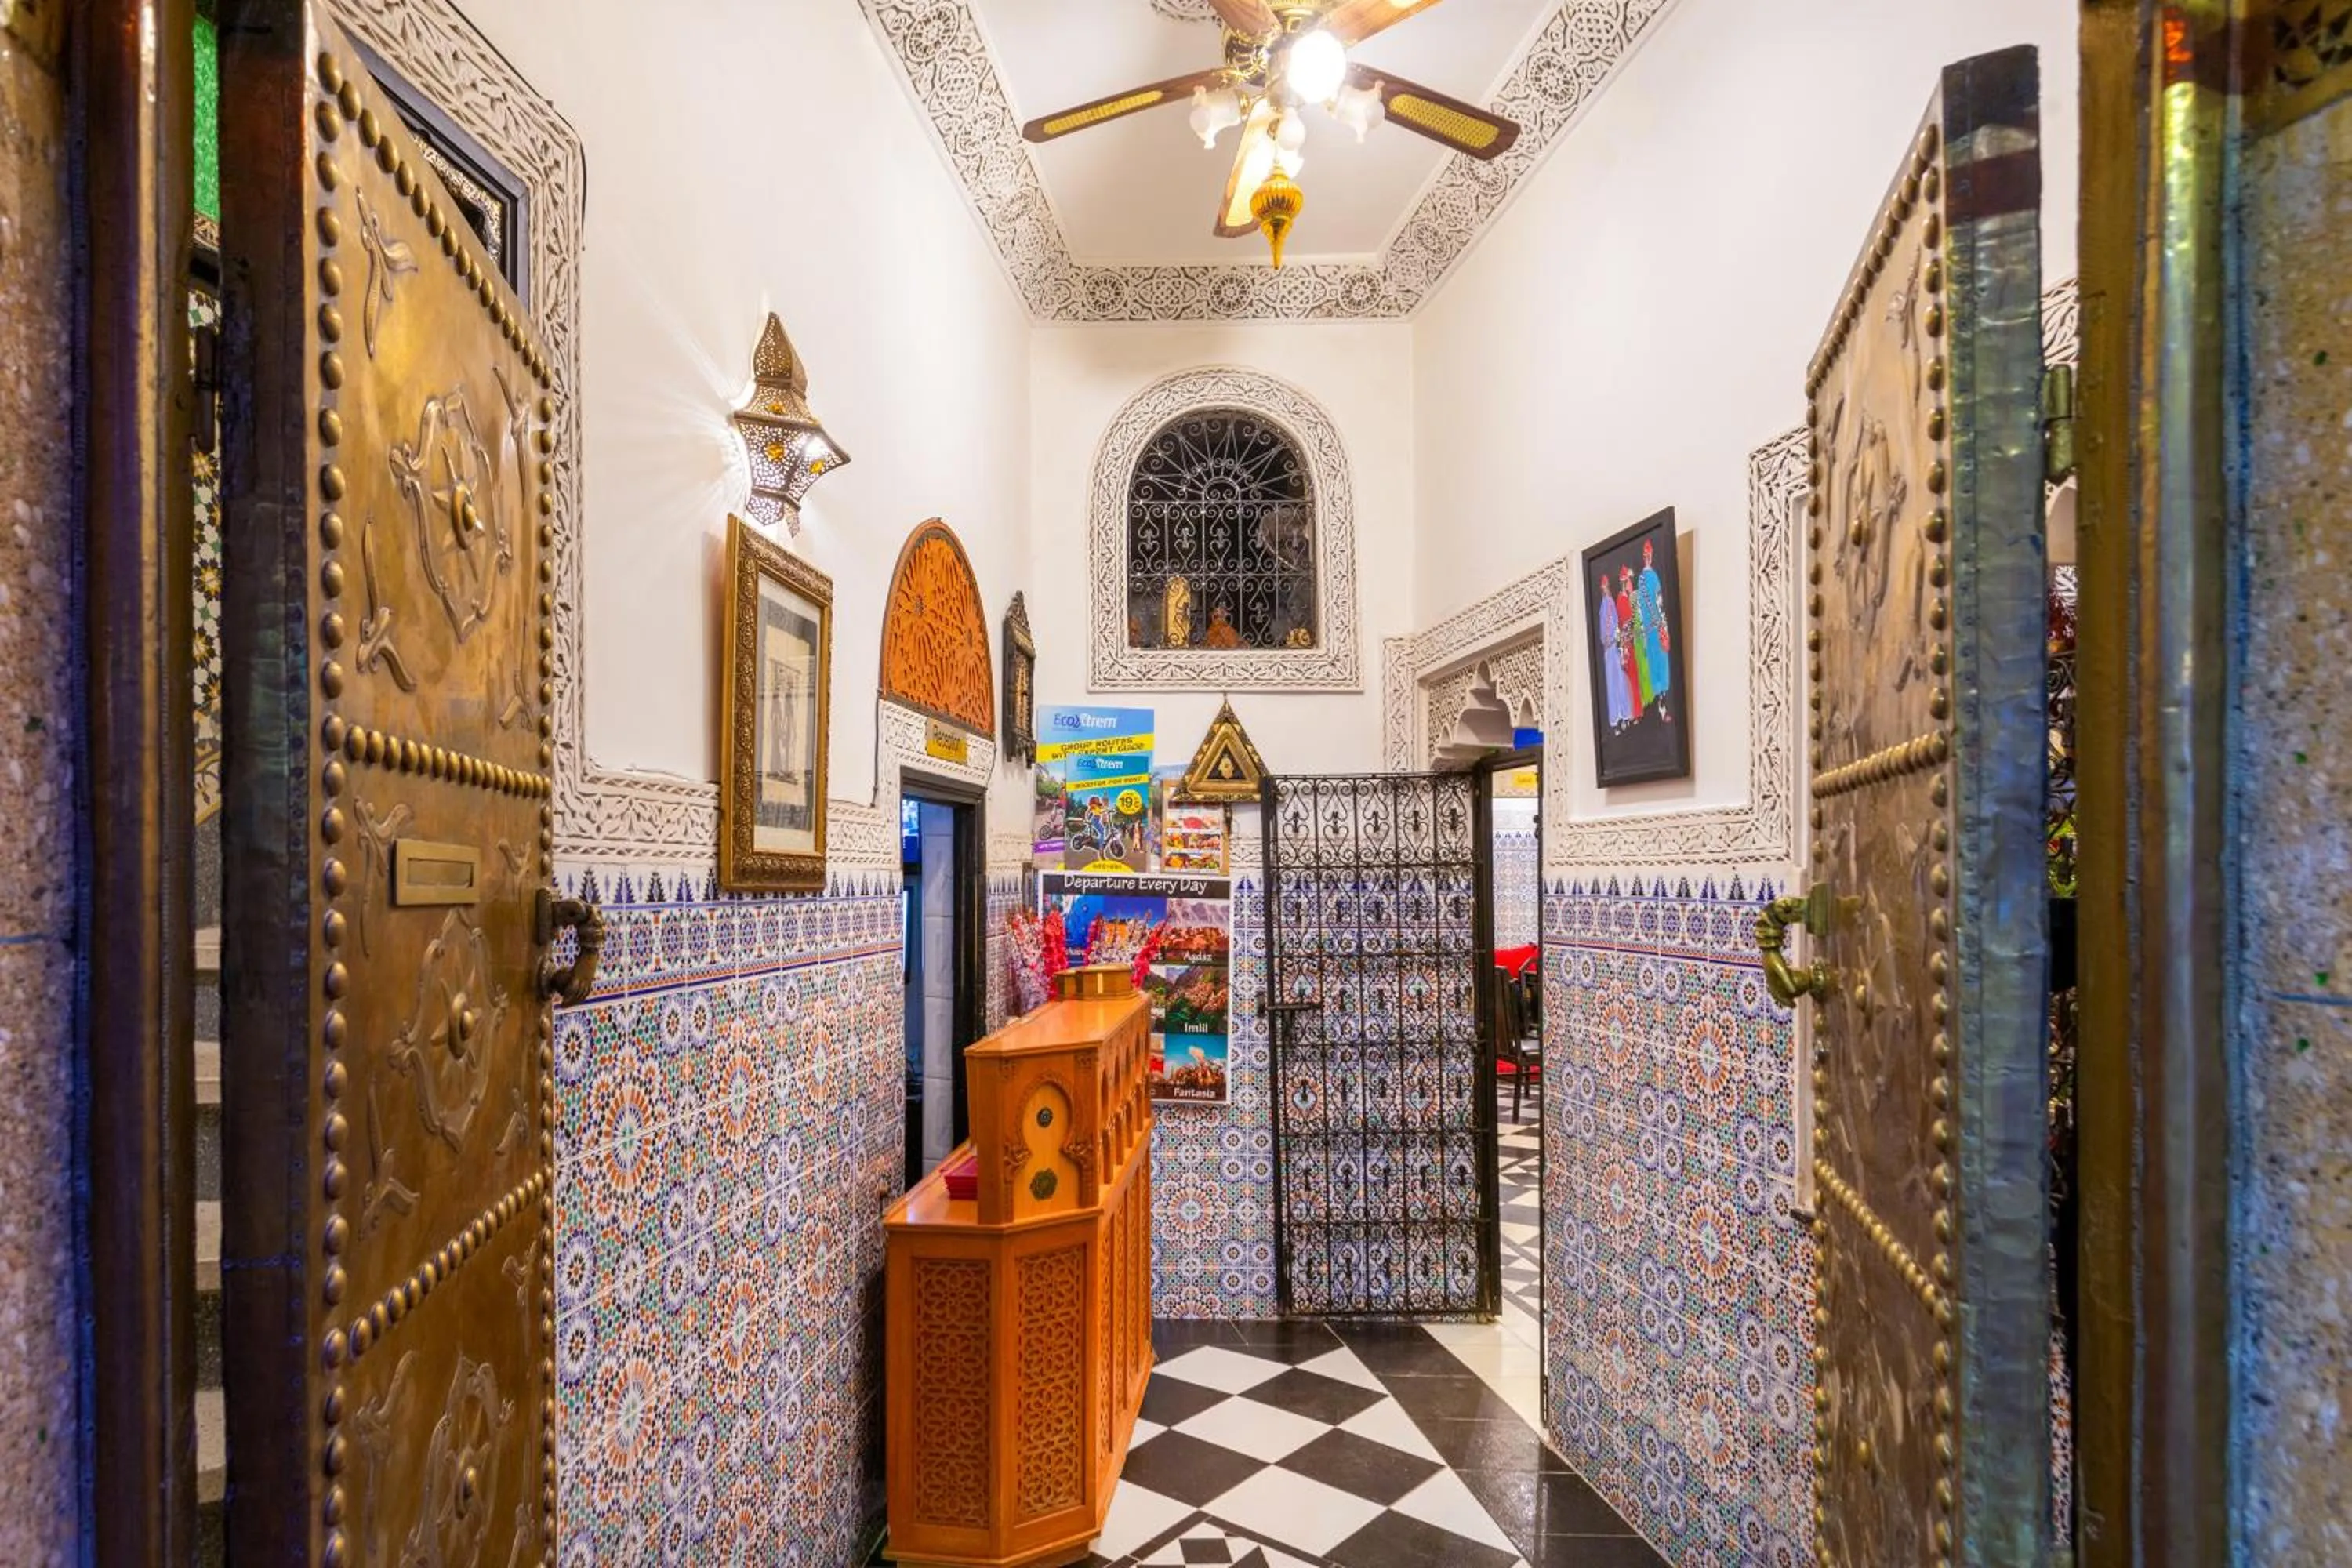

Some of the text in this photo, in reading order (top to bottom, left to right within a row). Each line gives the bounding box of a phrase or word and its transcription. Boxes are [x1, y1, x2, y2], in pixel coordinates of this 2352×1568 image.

[1064, 874, 1207, 895] Departure Every Day
[1185, 1022, 1208, 1033] Imlil
[1174, 1087, 1216, 1098] Fantasia
